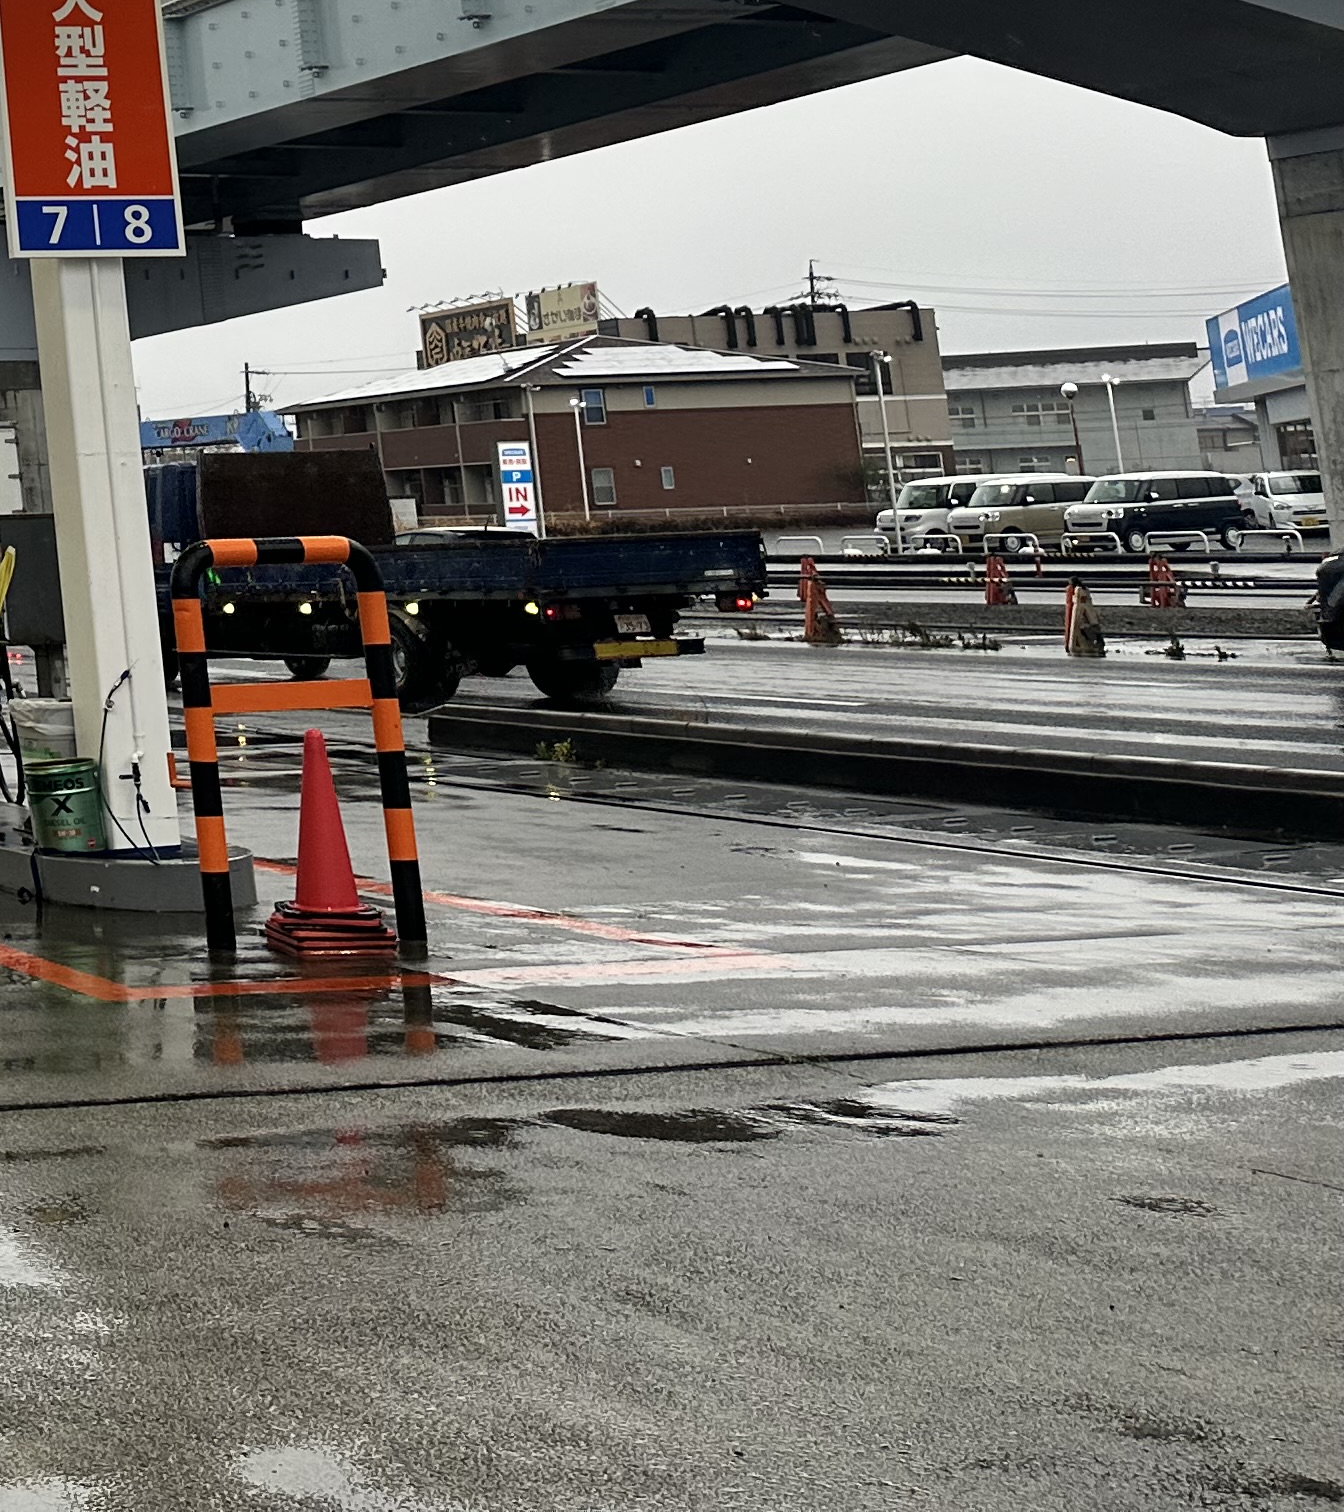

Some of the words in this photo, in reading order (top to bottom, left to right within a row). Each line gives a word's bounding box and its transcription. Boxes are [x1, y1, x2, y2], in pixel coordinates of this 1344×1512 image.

[41, 205, 69, 245] 7
[123, 203, 154, 245] 8
[1241, 305, 1289, 364] WECARS
[155, 427, 180, 439] CARGO
[512, 471, 522, 482] P
[508, 486, 529, 503] IN
[50, 793, 74, 817] X
